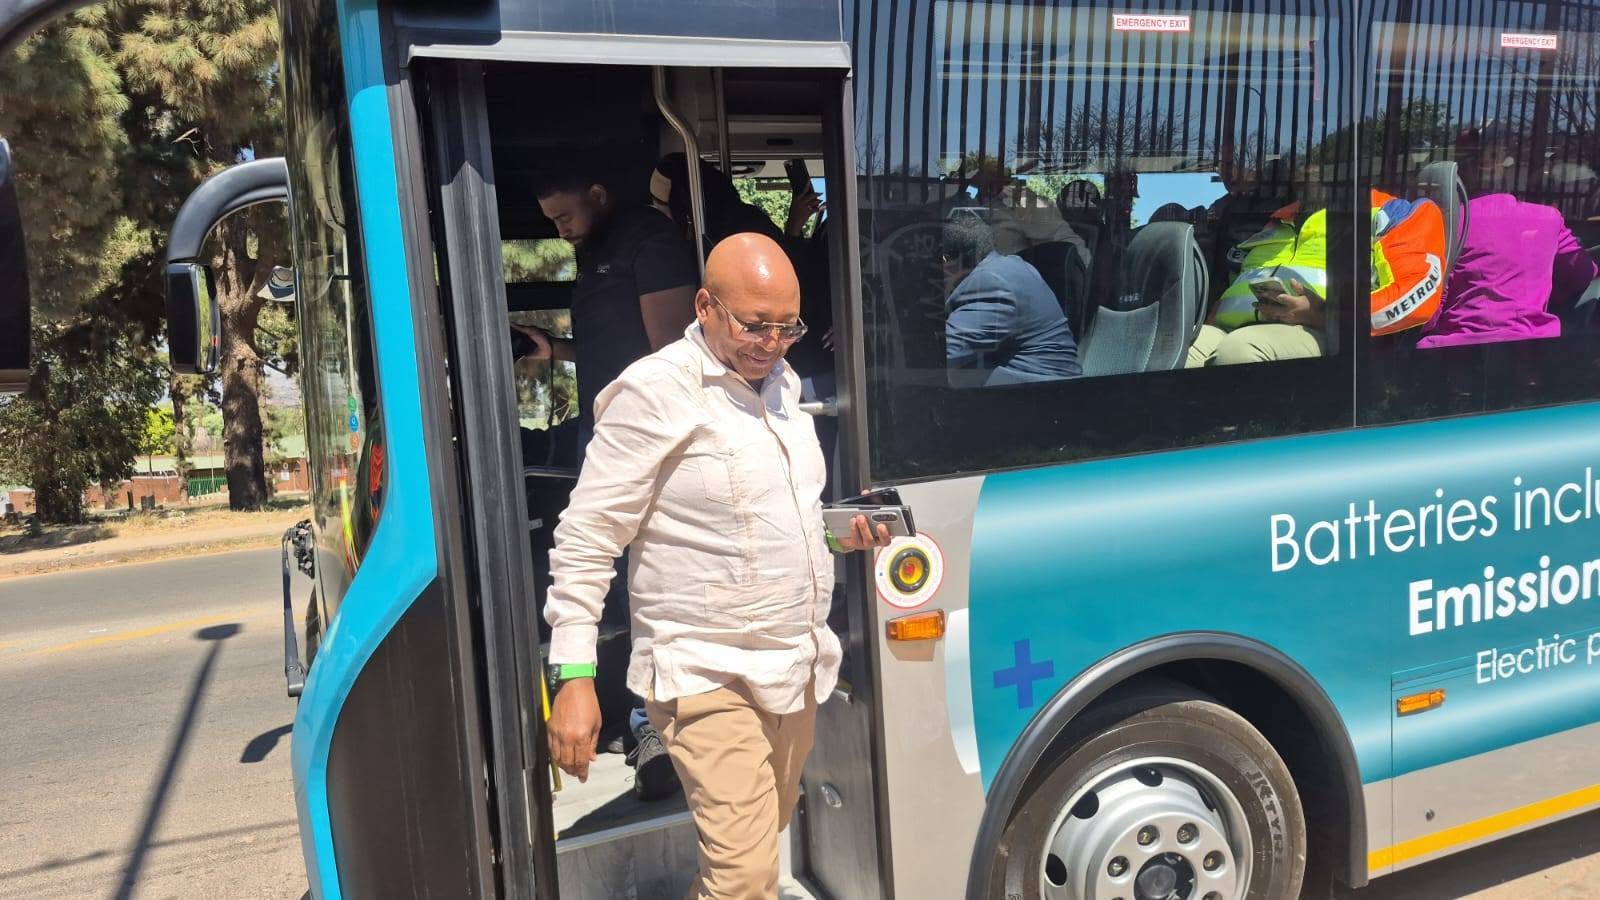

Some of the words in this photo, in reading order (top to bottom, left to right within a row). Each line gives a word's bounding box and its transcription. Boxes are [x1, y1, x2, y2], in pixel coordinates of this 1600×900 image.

[1116, 18, 1167, 27] EMERGENCY
[1169, 19, 1186, 28] EXIT
[1503, 36, 1540, 45] EMERGENCY
[1541, 38, 1554, 46] EXIT
[1271, 488, 1498, 572] Batteries
[1513, 466, 1600, 531] incl
[1409, 555, 1600, 636] Emission
[1476, 633, 1576, 684] Electric
